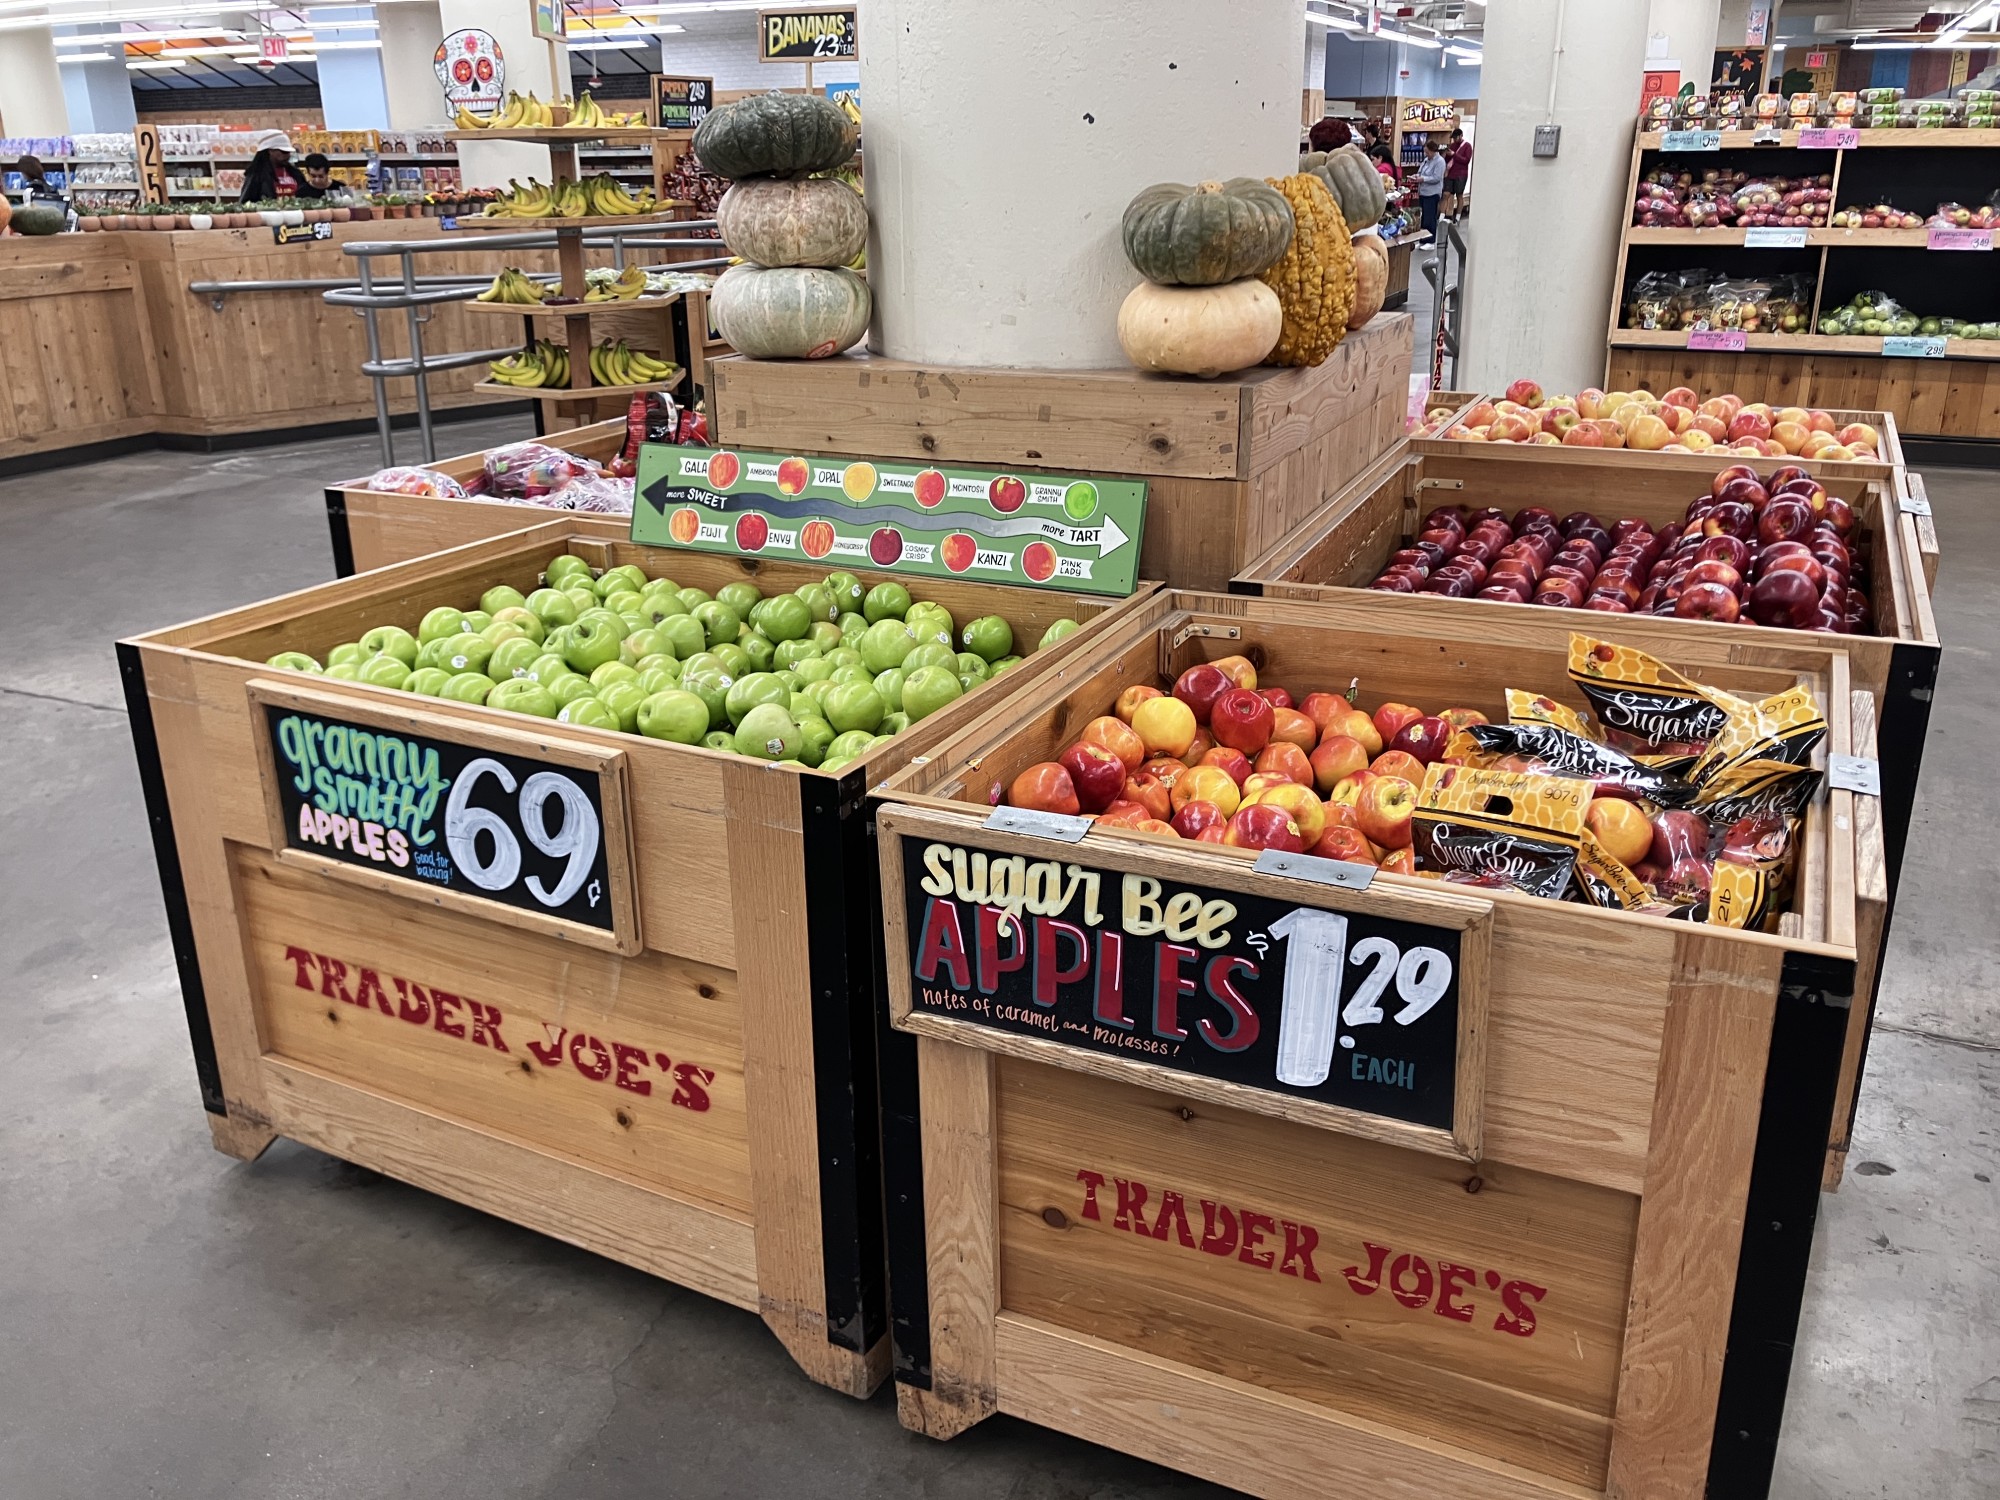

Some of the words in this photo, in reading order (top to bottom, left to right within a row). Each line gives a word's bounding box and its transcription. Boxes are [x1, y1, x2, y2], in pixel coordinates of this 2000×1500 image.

[768, 14, 846, 56] BANANAS
[263, 38, 286, 57] EXIT
[1403, 105, 1423, 120] NEW
[1425, 105, 1453, 121] ITEMS
[1925, 346, 1943, 355] 299
[684, 461, 707, 475] GALA
[750, 468, 777, 477] AMBROSIA
[818, 471, 841, 484] OPAL
[883, 478, 914, 490] SWEETANGO
[666, 490, 685, 499] more
[687, 488, 727, 510] SWEET
[1035, 487, 1062, 497] GRANNY
[1037, 495, 1058, 504] SMITH
[701, 526, 721, 539] FUJI
[768, 532, 791, 545] ENVY
[1041, 523, 1065, 537] more
[1070, 529, 1101, 543] TART
[905, 545, 930, 554] COSMIC
[905, 552, 926, 560] CRISP
[977, 553, 1007, 567] KANZI
[1061, 559, 1082, 569] PINK
[1060, 567, 1082, 577] LADY
[279, 715, 451, 821] granny
[1544, 787, 1571, 802] 907
[1571, 795, 1580, 807] g
[314, 765, 436, 846] smith
[300, 802, 410, 868] APPLES
[414, 851, 435, 867] Good
[436, 851, 449, 869] for
[1667, 879, 1686, 890] Extra
[920, 843, 1104, 938] Sugar
[1122, 872, 1238, 949] Bee
[914, 896, 1261, 1053] APPLES
[923, 987, 968, 1010] notes
[973, 998, 990, 1018] of
[995, 1003, 1060, 1032] caramel
[1062, 1020, 1090, 1034] and
[285, 945, 510, 1053] TRADER
[526, 1021, 716, 1113] JOE'S
[1352, 1053, 1416, 1090] EACH
[1076, 1168, 1322, 1284] TRADER
[1340, 1240, 1548, 1338] JOE'S
